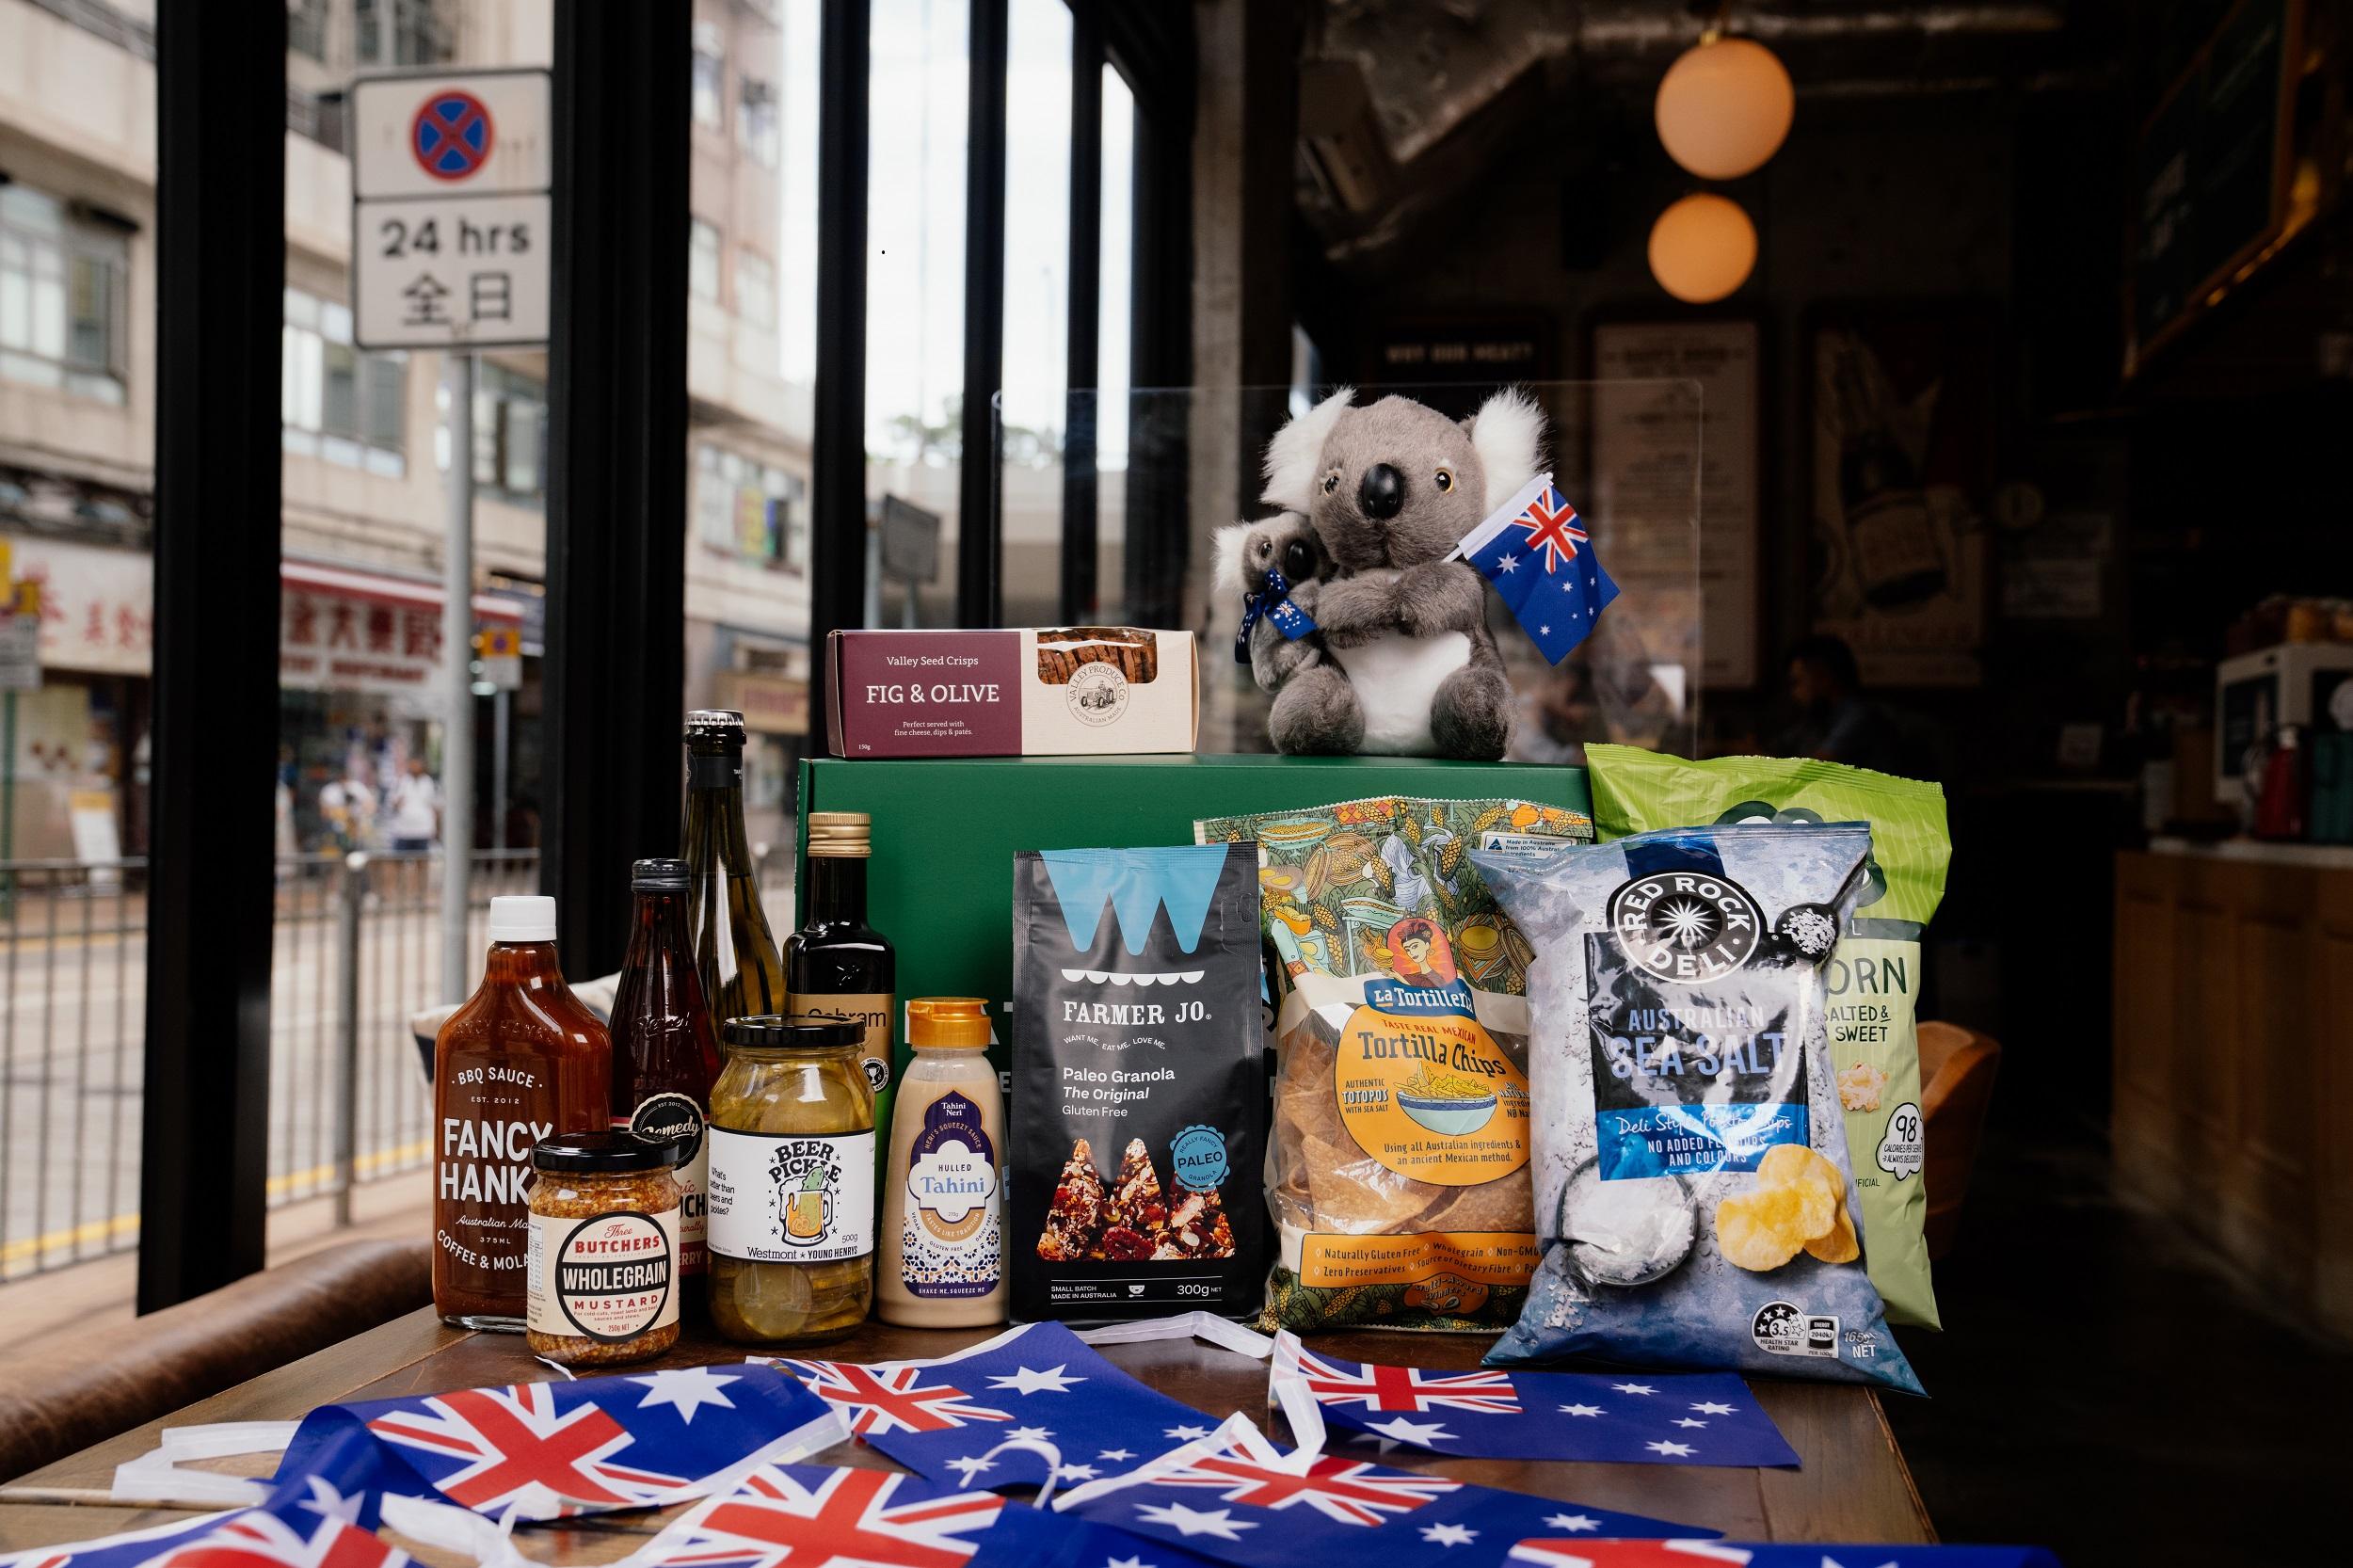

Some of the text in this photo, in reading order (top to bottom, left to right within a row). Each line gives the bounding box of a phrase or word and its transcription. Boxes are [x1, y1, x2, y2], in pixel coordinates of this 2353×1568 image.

[381, 216, 530, 258] 24 hrs
[402, 272, 511, 326] 全日
[887, 656, 979, 667] Valley Seed Crisps
[1069, 664, 1124, 701] VALLEY PRODUCE
[866, 684, 1000, 703] FIG & OLIVE
[1074, 706, 1107, 723] AUSTRALIAN
[908, 728, 932, 737] cheese,
[933, 728, 947, 737] dips
[1625, 876, 1751, 931] RED ROCK
[1645, 943, 1738, 977] DELI
[1374, 987, 1475, 1014] La Tortilleria
[1063, 1000, 1165, 1026] FARMER
[1628, 1007, 1765, 1032] AUSTRALIAN
[1881, 1005, 1892, 1022] &
[1382, 1018, 1476, 1045] TASTE REAL MEXICAN
[1835, 1026, 1888, 1042] SWEET
[1064, 1034, 1085, 1044] WANT
[1086, 1035, 1099, 1047] ME.
[1101, 1043, 1115, 1051] EAT
[1117, 1041, 1130, 1051] ME.
[1153, 1038, 1166, 1049] ME.
[1357, 1032, 1507, 1078] Tortilla Chips
[1610, 1032, 1787, 1079] SEA SALT
[457, 1066, 535, 1088] BBQ SAUCE
[1063, 1067, 1176, 1082] Paleo Granola
[1345, 1079, 1385, 1088] AUTHENTIC
[1063, 1086, 1149, 1103] The Original
[1342, 1089, 1388, 1104] TOTOPOS
[1062, 1105, 1128, 1117] Gluten Free
[1375, 1104, 1388, 1112] SALT
[1615, 1116, 1651, 1135] Deli
[1896, 1114, 1917, 1142] 98
[444, 1118, 552, 1161] FANCY
[924, 1122, 982, 1149] NERI'S SQUEEZY SAUCE
[775, 1140, 834, 1163] BEER
[1179, 1136, 1218, 1154] REALLY FANCY
[1384, 1139, 1522, 1154] Using all Australian ingredients &
[1648, 1137, 1704, 1153] NO ADDED
[1884, 1144, 1905, 1153] CALORIES
[1177, 1151, 1223, 1168] PALEO
[1411, 1154, 1443, 1165] ancient
[1446, 1154, 1479, 1163] Mexican
[1481, 1152, 1513, 1163] method.
[1669, 1149, 1747, 1166] AND COLOURS
[1887, 1155, 1903, 1163] ALWAYS
[938, 1163, 972, 1172] HULLED
[1189, 1170, 1217, 1181] GRANOLA
[721, 1183, 735, 1193] than
[920, 1176, 984, 1193] Tahini
[721, 1196, 732, 1205] and
[456, 1214, 506, 1228] Australian
[911, 1211, 920, 1231] VEGAN
[925, 1212, 981, 1237] TASTES LIKE TRADITION
[480, 1236, 510, 1244] 375ML
[604, 1224, 632, 1239] Three
[841, 1233, 858, 1243] 500g
[975, 1226, 987, 1242] DAIRY
[437, 1229, 477, 1266] COFFEE
[479, 1255, 489, 1270] &
[575, 1236, 660, 1254] BUTCHERS
[746, 1245, 857, 1259] Westmont YOUNG HENRYS
[929, 1240, 949, 1252] GLUTEN
[1324, 1241, 1484, 1262] Naturally Gluten Free Wholegrain
[563, 1260, 666, 1290] WHOLEGRAIN
[1324, 1256, 1512, 1277] Zero Preservatives Source Dietary Fibre
[1176, 1285, 1209, 1297] 300g
[574, 1295, 658, 1310] MUSTARD
[1771, 1322, 1790, 1336] 3.5
[1852, 1345, 1876, 1358] NET
